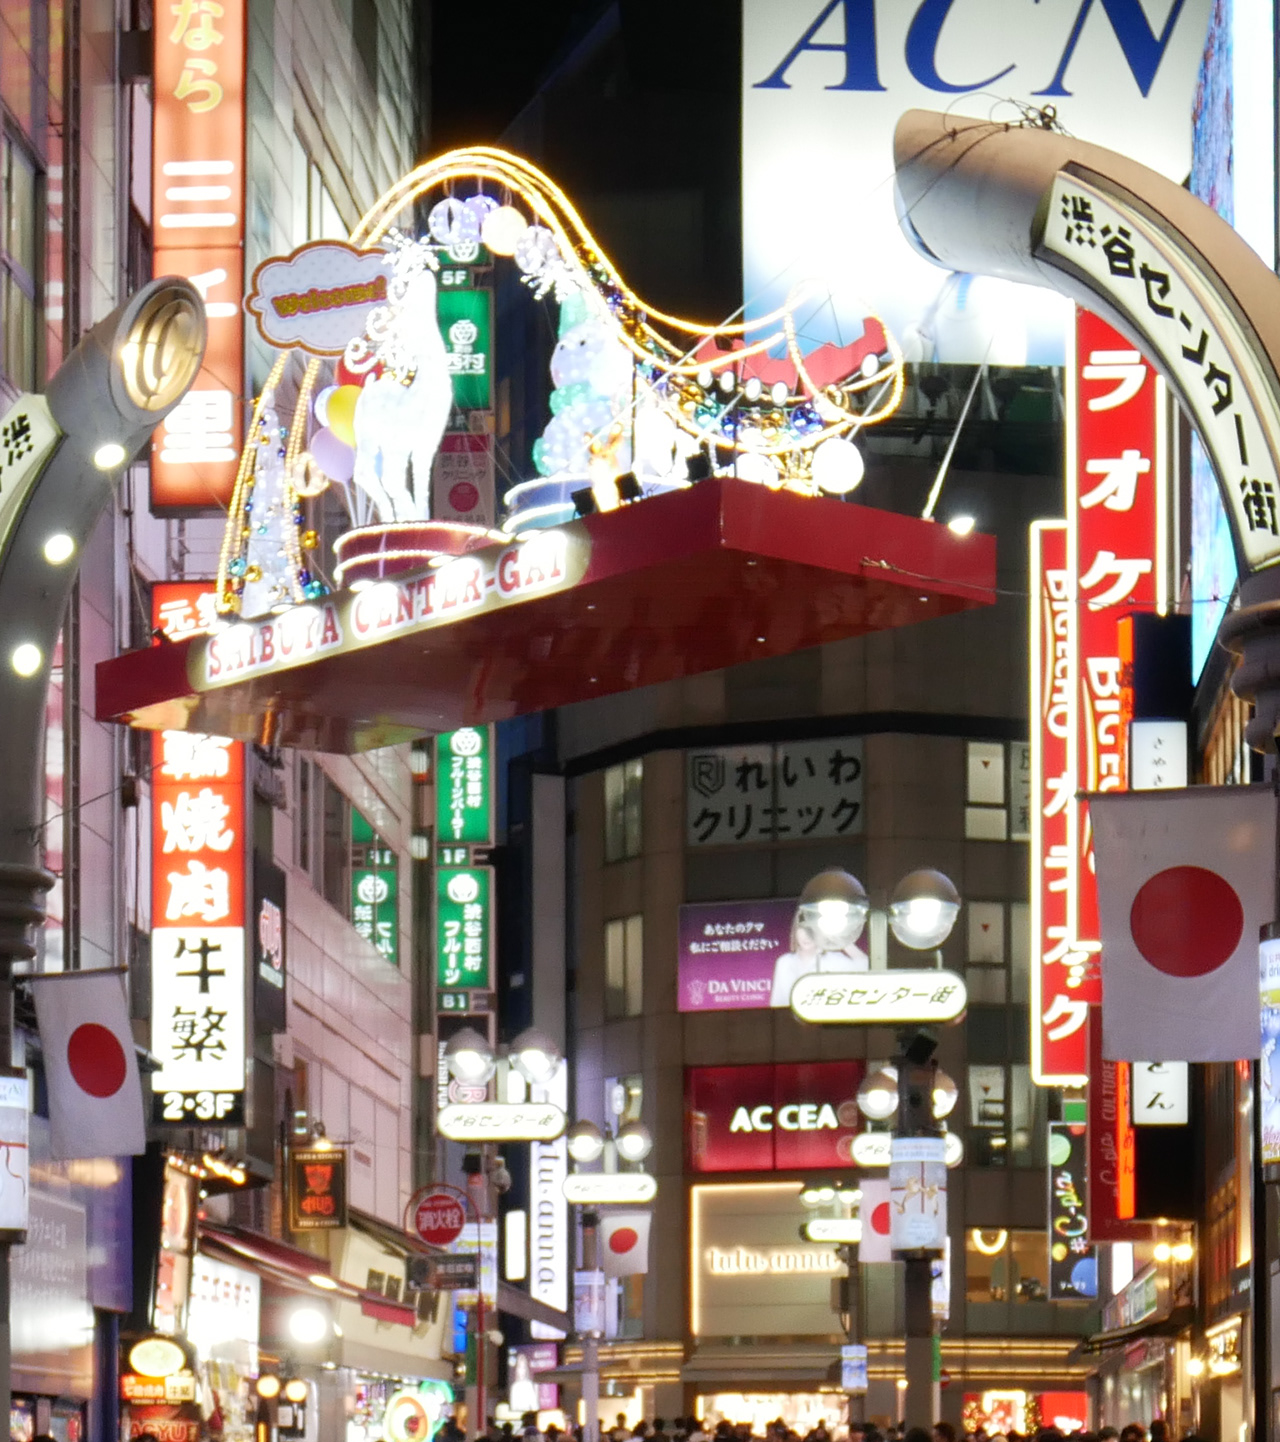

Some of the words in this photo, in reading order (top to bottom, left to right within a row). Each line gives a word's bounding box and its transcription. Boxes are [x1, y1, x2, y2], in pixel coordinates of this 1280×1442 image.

[1060, 193, 1279, 537] 渋谷センター街
[735, 748, 862, 793] れいわ
[693, 798, 861, 843] クリニック
[443, 849, 466, 864] 1F
[443, 921, 462, 985] フルーツ
[464, 903, 482, 972] 渋谷西村
[172, 937, 228, 1062] 牛繁
[442, 993, 466, 1009] B1
[801, 984, 959, 1006] 渋谷センター街
[417, 1208, 462, 1232] 消火栓
